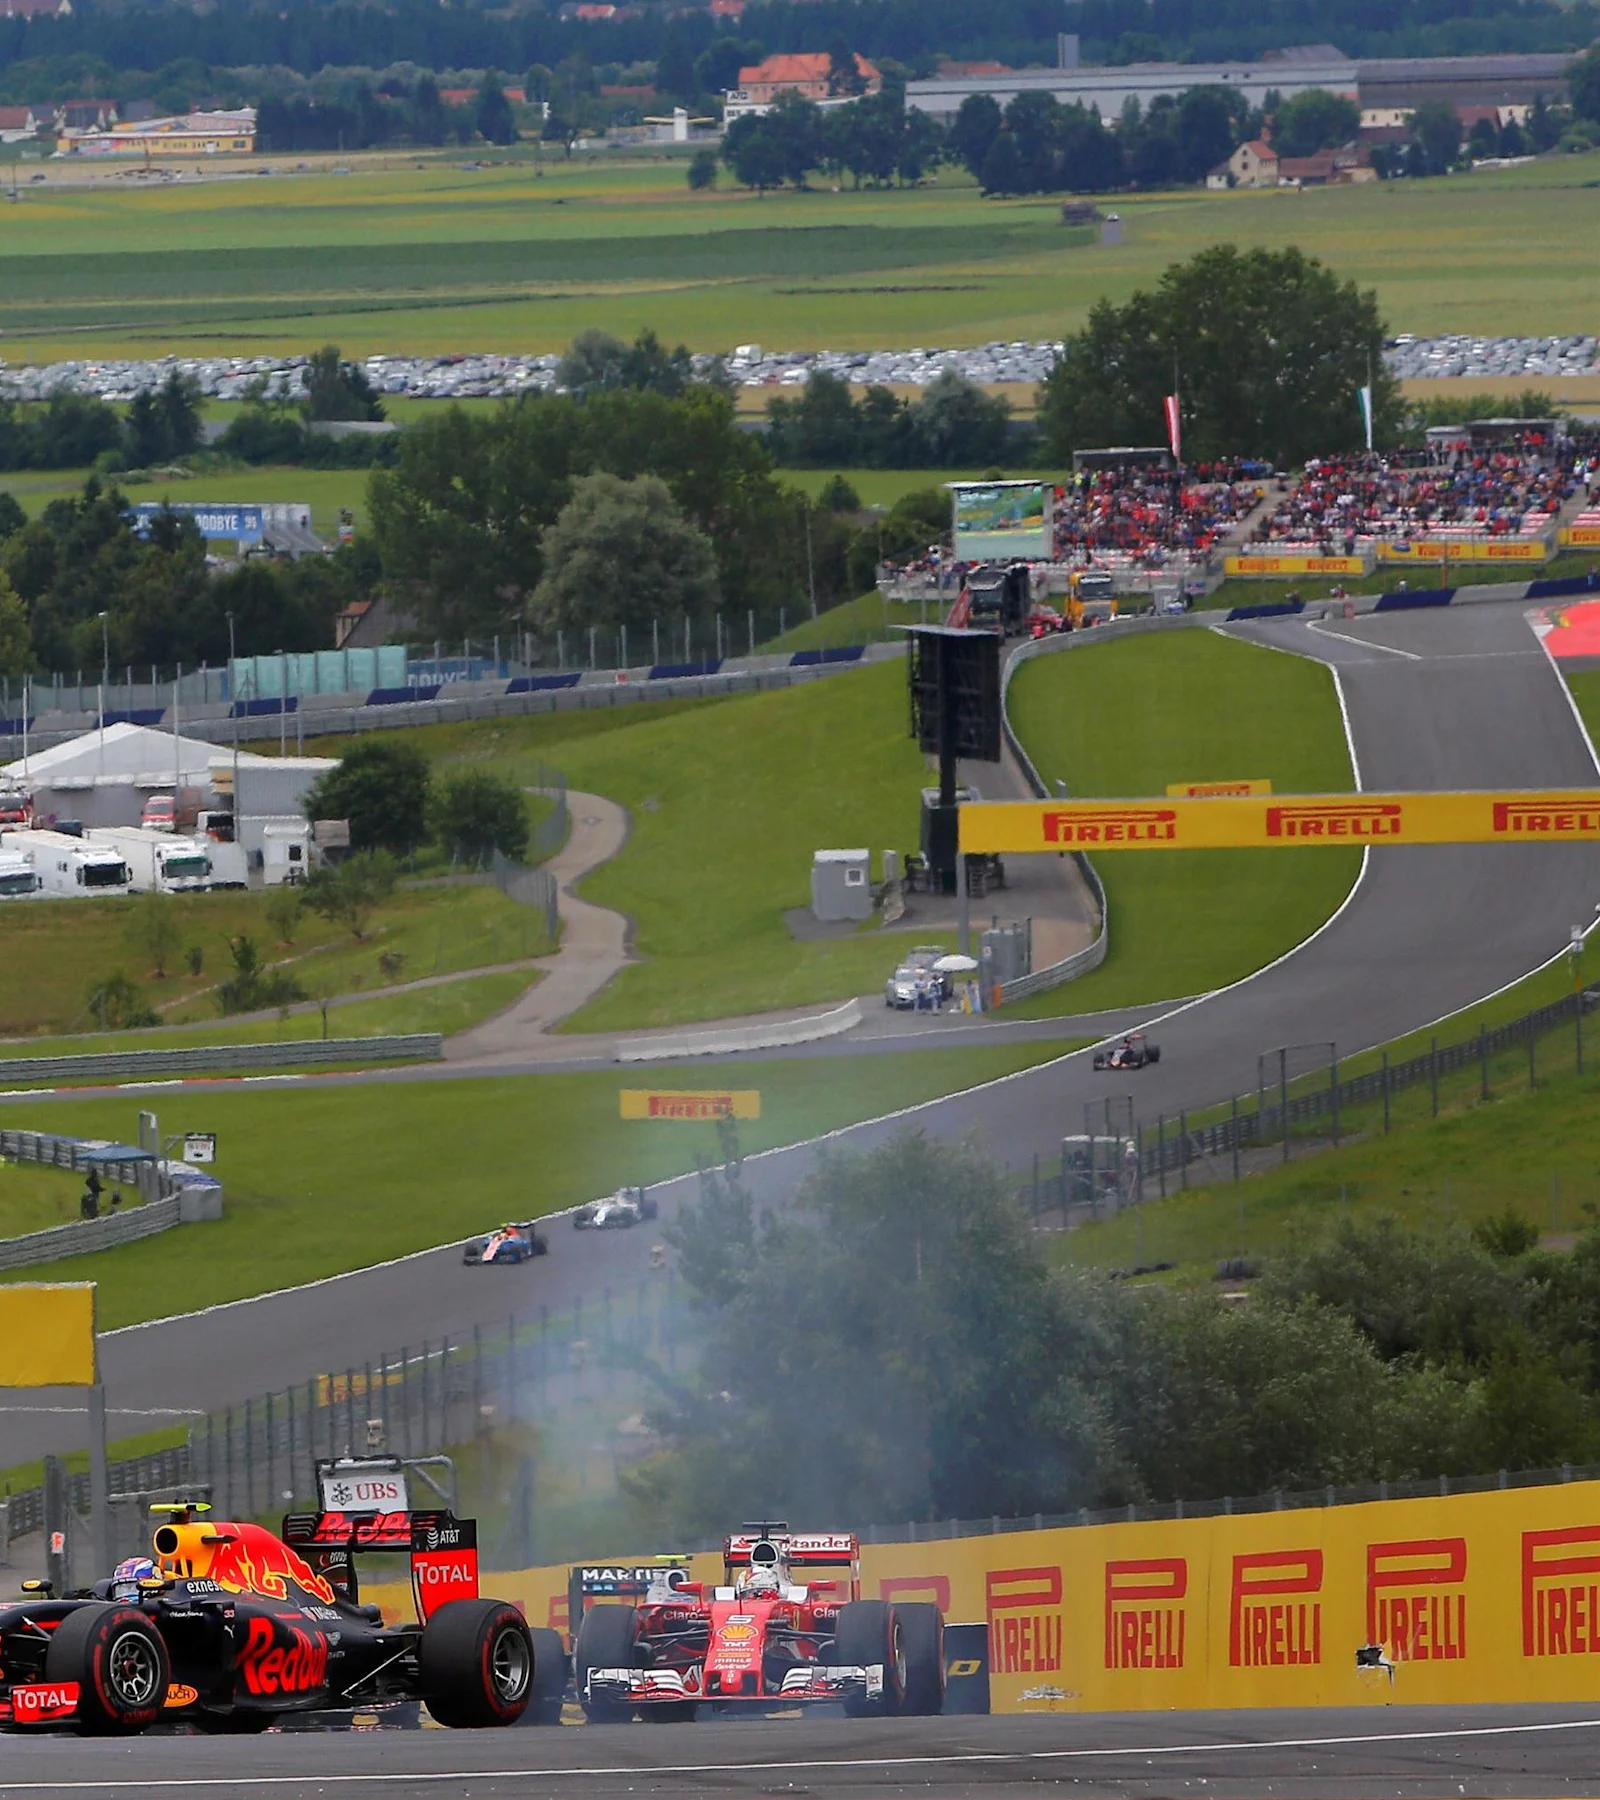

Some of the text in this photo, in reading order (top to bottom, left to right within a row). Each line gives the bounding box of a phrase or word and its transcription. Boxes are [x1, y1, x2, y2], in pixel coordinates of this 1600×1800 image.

[1043, 810, 1176, 842] PIRELLI
[1266, 804, 1401, 836] PIRELLI
[1493, 800, 1600, 832] PIREL
[356, 1482, 398, 1500] UBS
[440, 1529, 460, 1543] AT&T
[415, 1562, 473, 1585] TOTAL
[582, 1568, 652, 1581] MARTI
[1367, 1537, 1467, 1663] PIRELLI
[1522, 1525, 1600, 1657] PIREL
[224, 1609, 235, 1618] 33
[725, 1614, 756, 1624] 5
[813, 1607, 840, 1619] Clar
[985, 1565, 1063, 1674] PIRELLI
[1105, 1557, 1187, 1669] PIRELLI
[1229, 1548, 1323, 1667] PIRELLI
[13, 1688, 78, 1709] TOTAL
